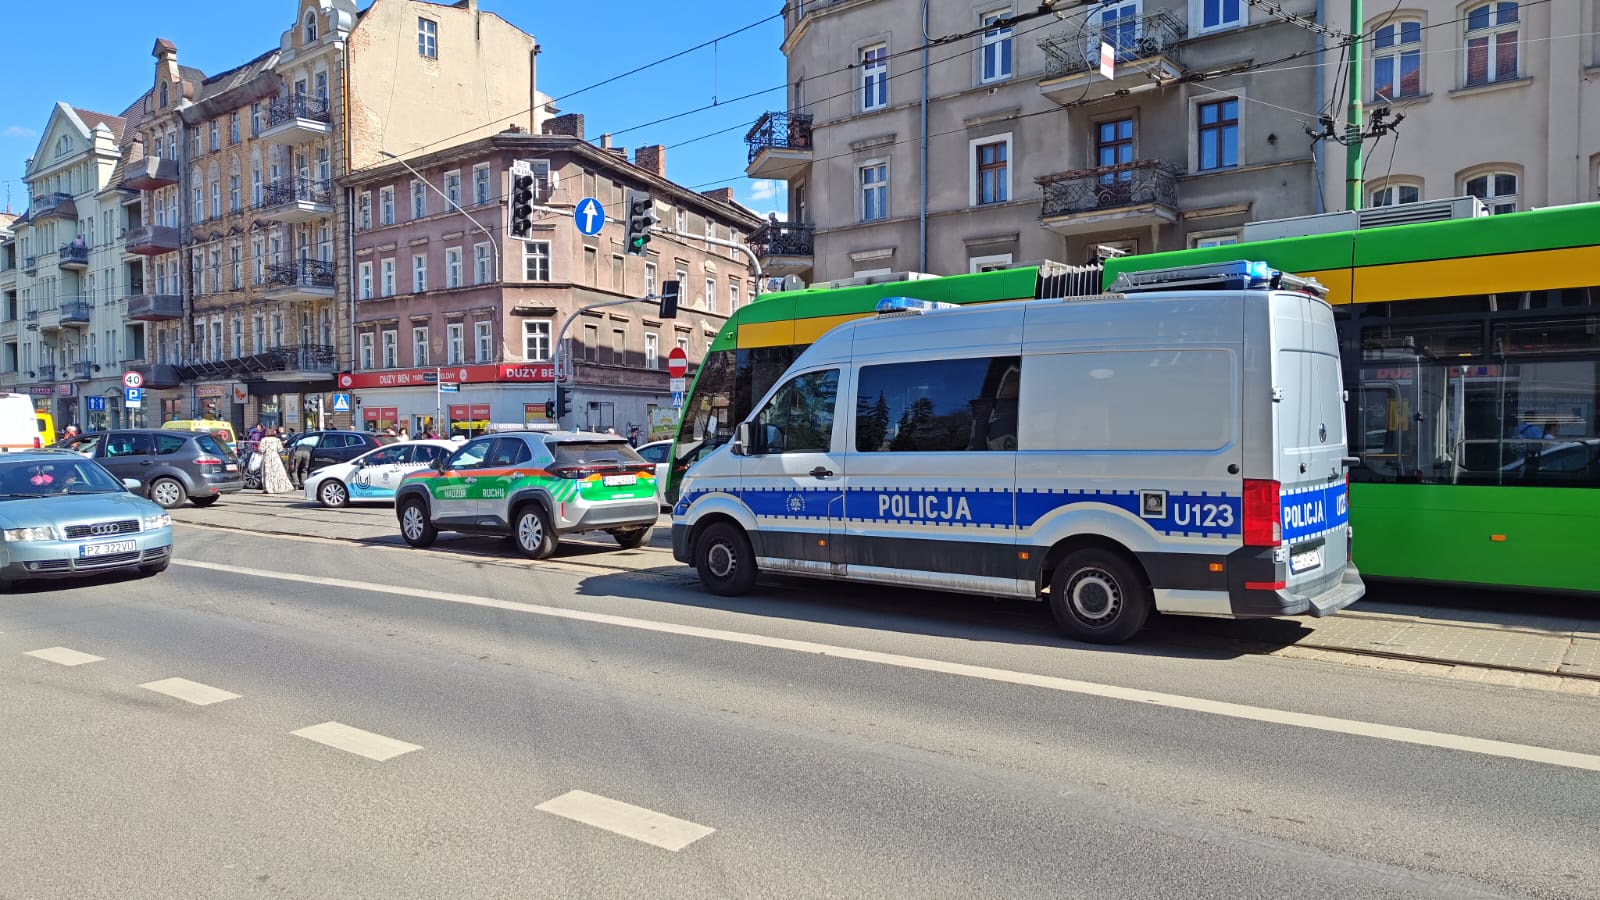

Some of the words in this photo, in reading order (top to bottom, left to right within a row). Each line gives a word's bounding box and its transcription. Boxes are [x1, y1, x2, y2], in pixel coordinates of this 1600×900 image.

[506, 366, 537, 378] DUŻY
[126, 376, 140, 385] 40
[397, 374, 410, 383] BEN
[128, 389, 138, 400] P
[482, 487, 504, 498] RUCHU
[879, 495, 971, 520] POLICJA
[1174, 504, 1233, 527] U123
[1284, 501, 1324, 529] POLICJA
[87, 546, 100, 556] PZ
[104, 541, 134, 553] 322VU
